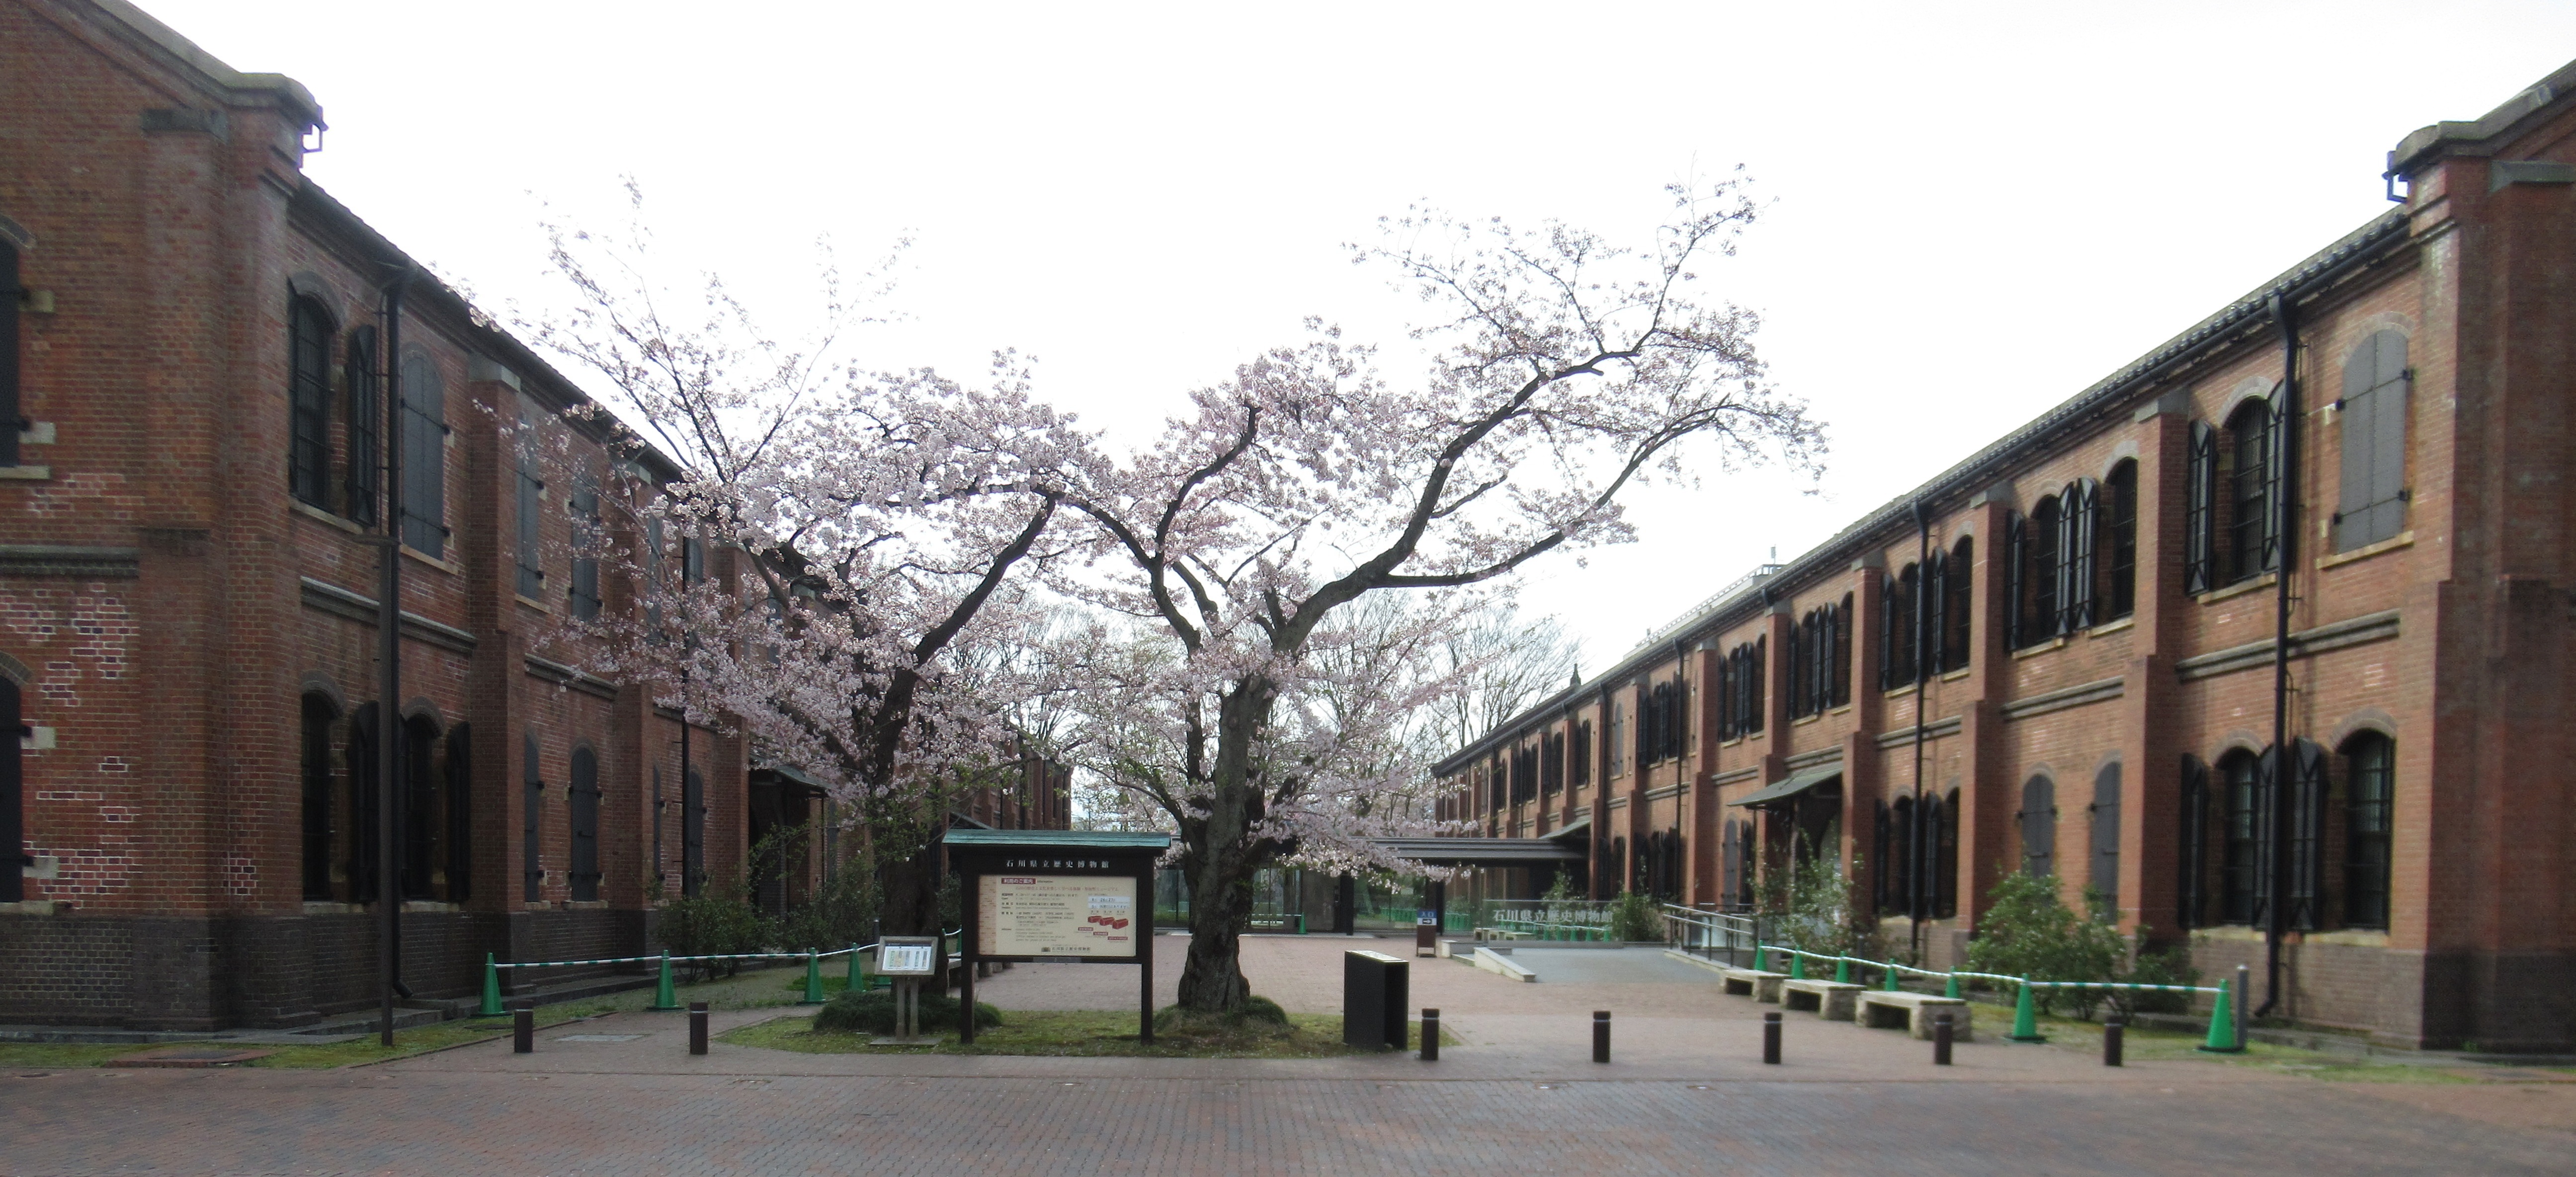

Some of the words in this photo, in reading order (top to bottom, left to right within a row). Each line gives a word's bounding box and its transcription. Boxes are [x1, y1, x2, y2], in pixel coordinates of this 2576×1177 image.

[1006, 860, 1109, 868] 石川県立歴史博物館
[1493, 909, 1613, 923] 石川県立歴史博物館
